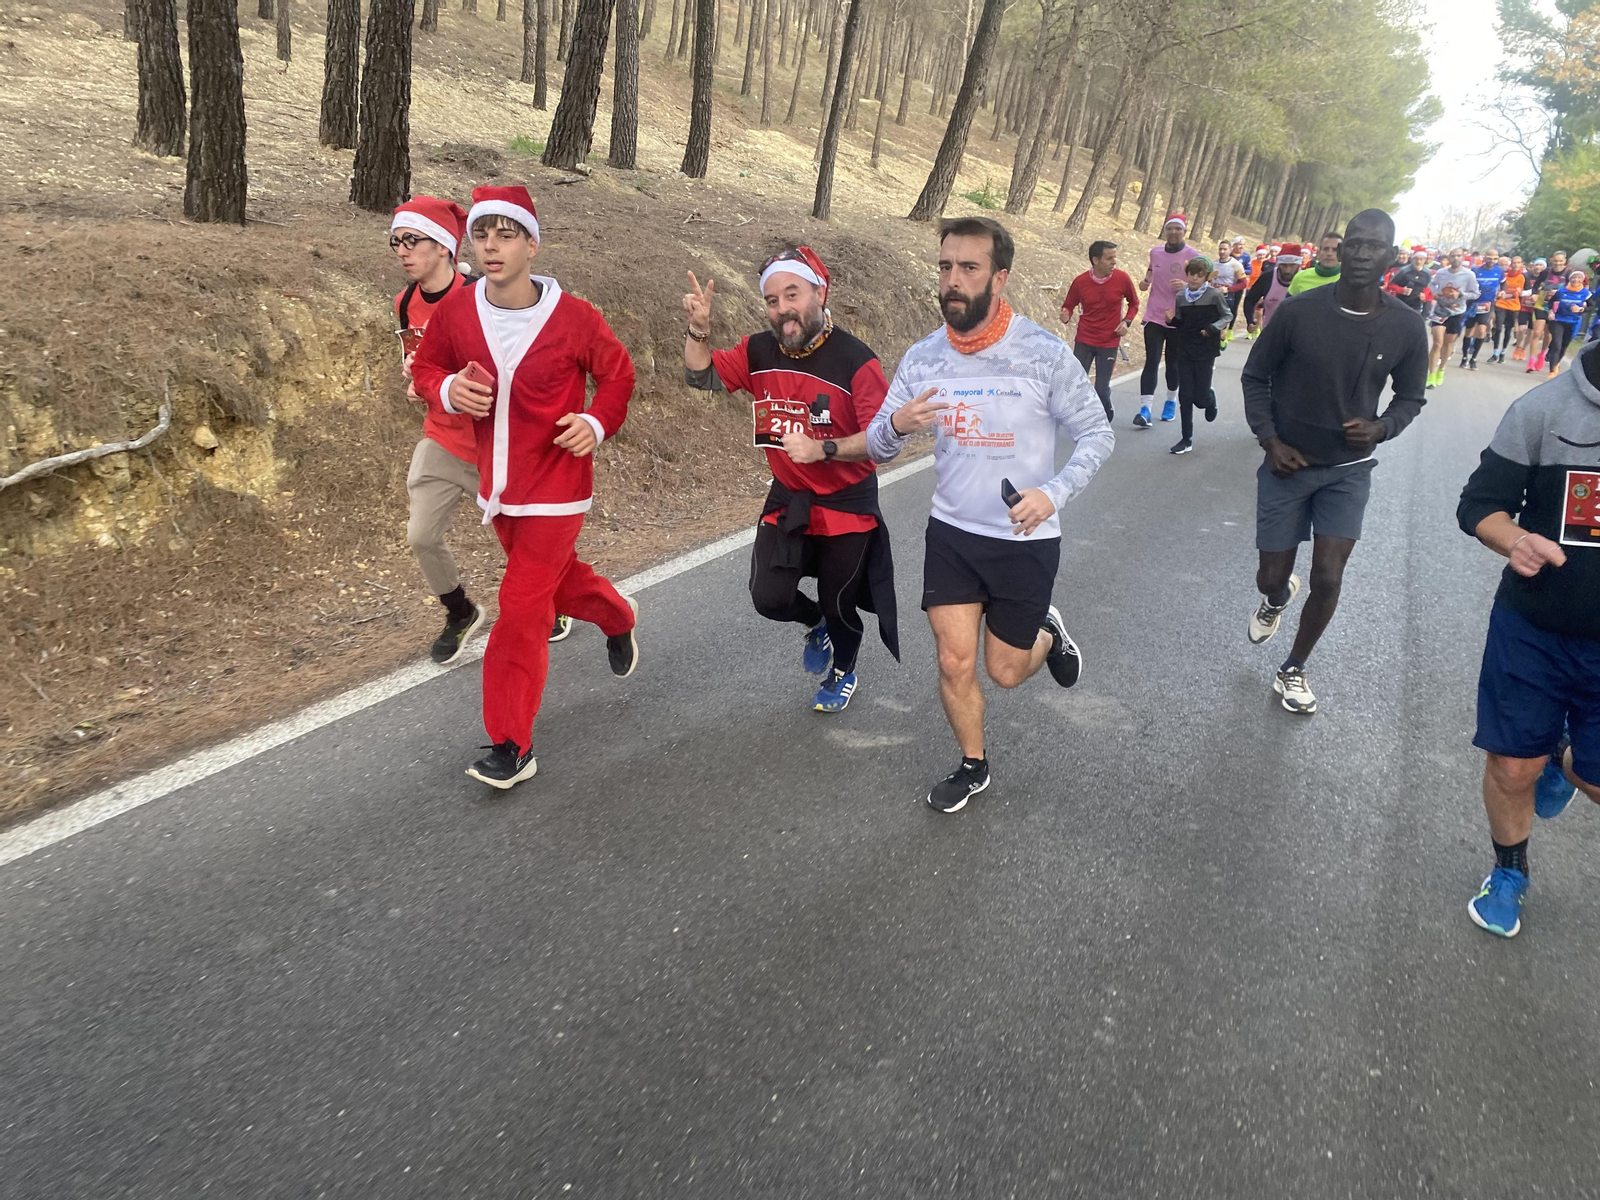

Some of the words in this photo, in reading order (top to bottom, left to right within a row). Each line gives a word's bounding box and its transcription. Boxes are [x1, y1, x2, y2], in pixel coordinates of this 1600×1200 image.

[953, 389, 983, 397] mayoral
[995, 389, 1022, 397] CaixaBank
[770, 418, 804, 434] 210
